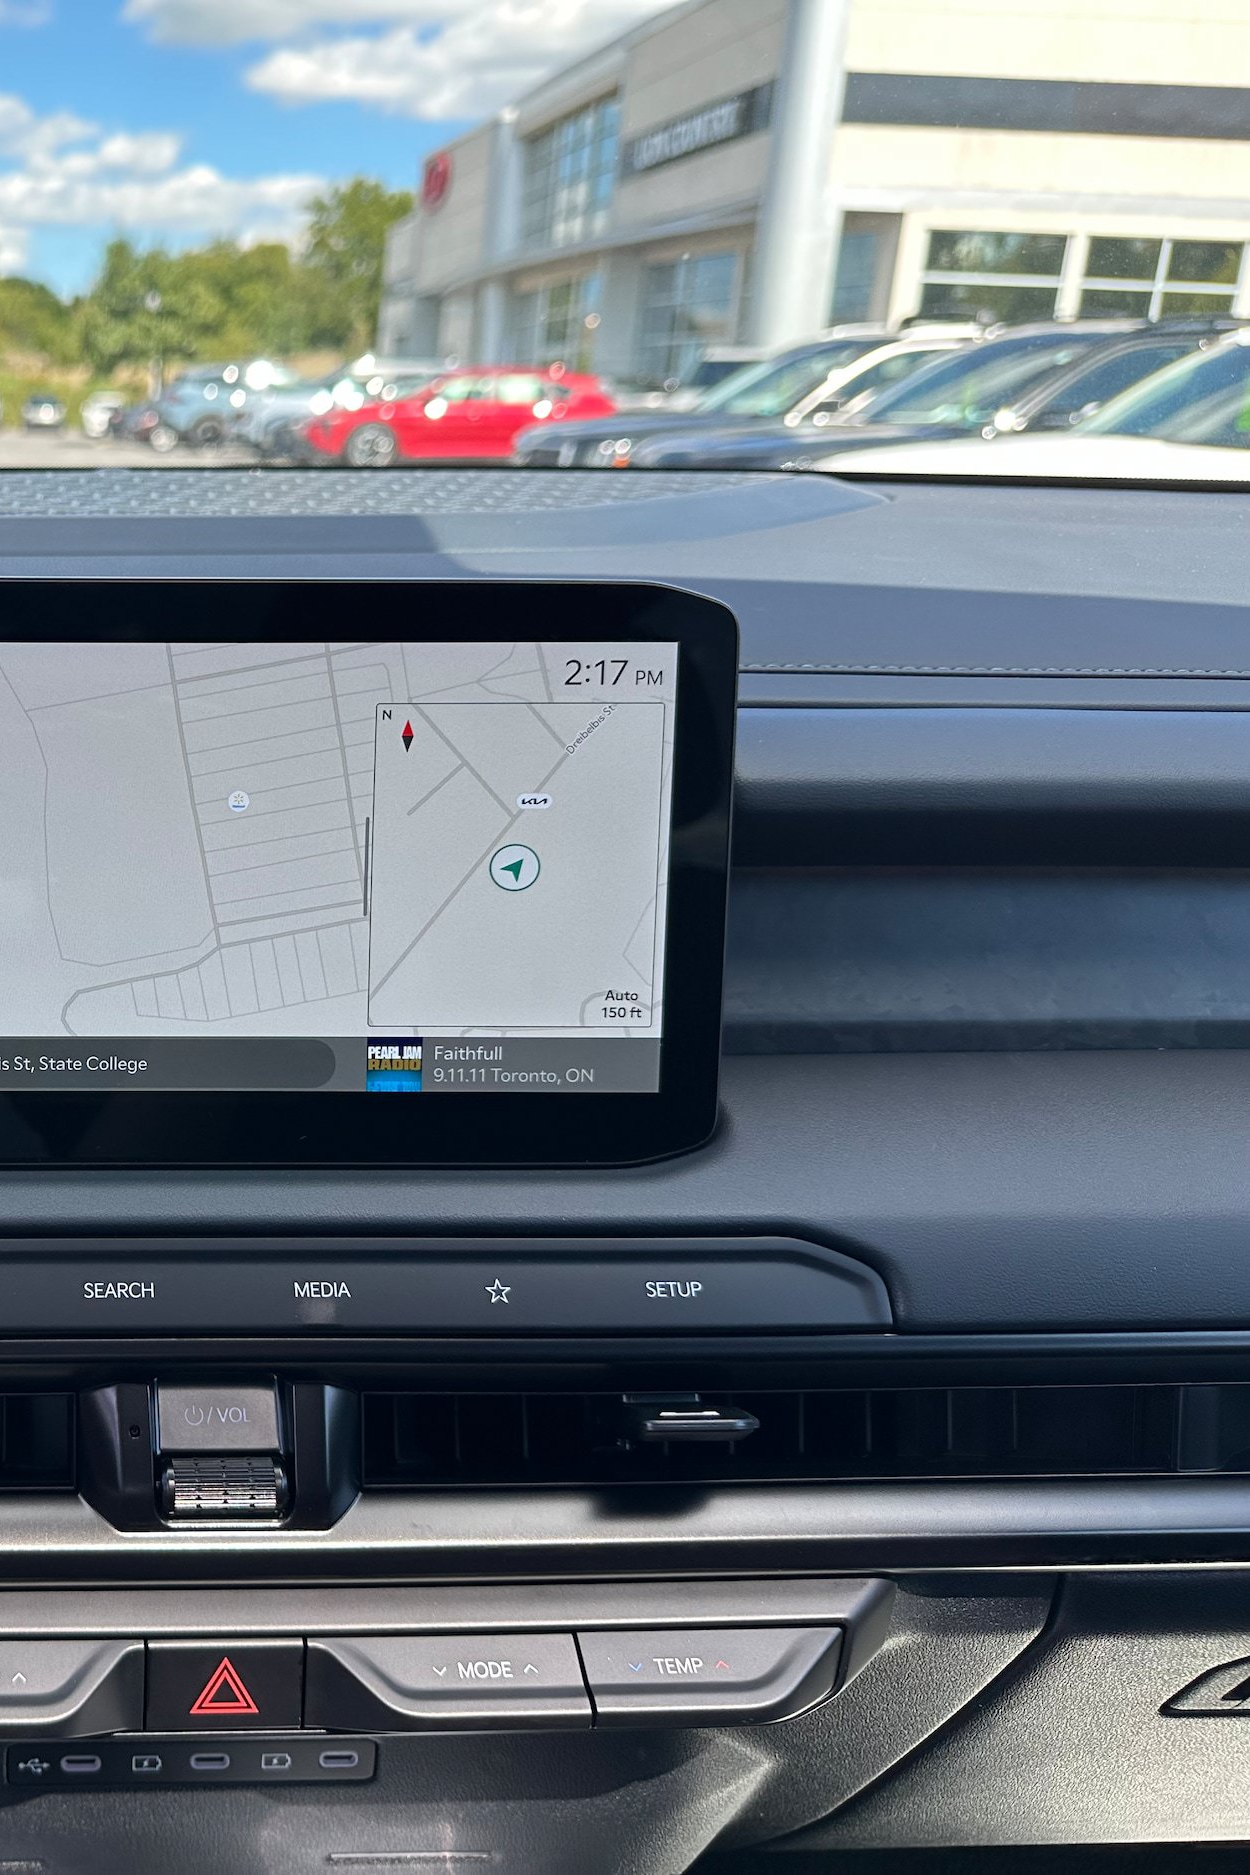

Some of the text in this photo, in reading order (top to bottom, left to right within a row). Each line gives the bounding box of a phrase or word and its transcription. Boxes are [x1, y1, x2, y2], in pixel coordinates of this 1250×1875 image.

[564, 659, 663, 686] 2:17 PM
[382, 709, 392, 721] N
[566, 705, 615, 754] Dreibelbis St
[604, 989, 639, 1002] Auto
[601, 1005, 642, 1018] 150 ft
[367, 1046, 422, 1060] PEARL JAM
[434, 1045, 503, 1061] Faithfull
[13, 1057, 35, 1075] St,
[39, 1057, 83, 1072] State
[86, 1057, 148, 1076] College
[367, 1059, 422, 1071] RADIO
[433, 1067, 594, 1085] 9.11.11 Toronto, ON
[83, 1282, 155, 1299] SEARCH
[293, 1280, 352, 1298] MEDIA
[645, 1280, 702, 1298] SETUP
[456, 1660, 514, 1681] MODE
[652, 1656, 704, 1676] TEMP
